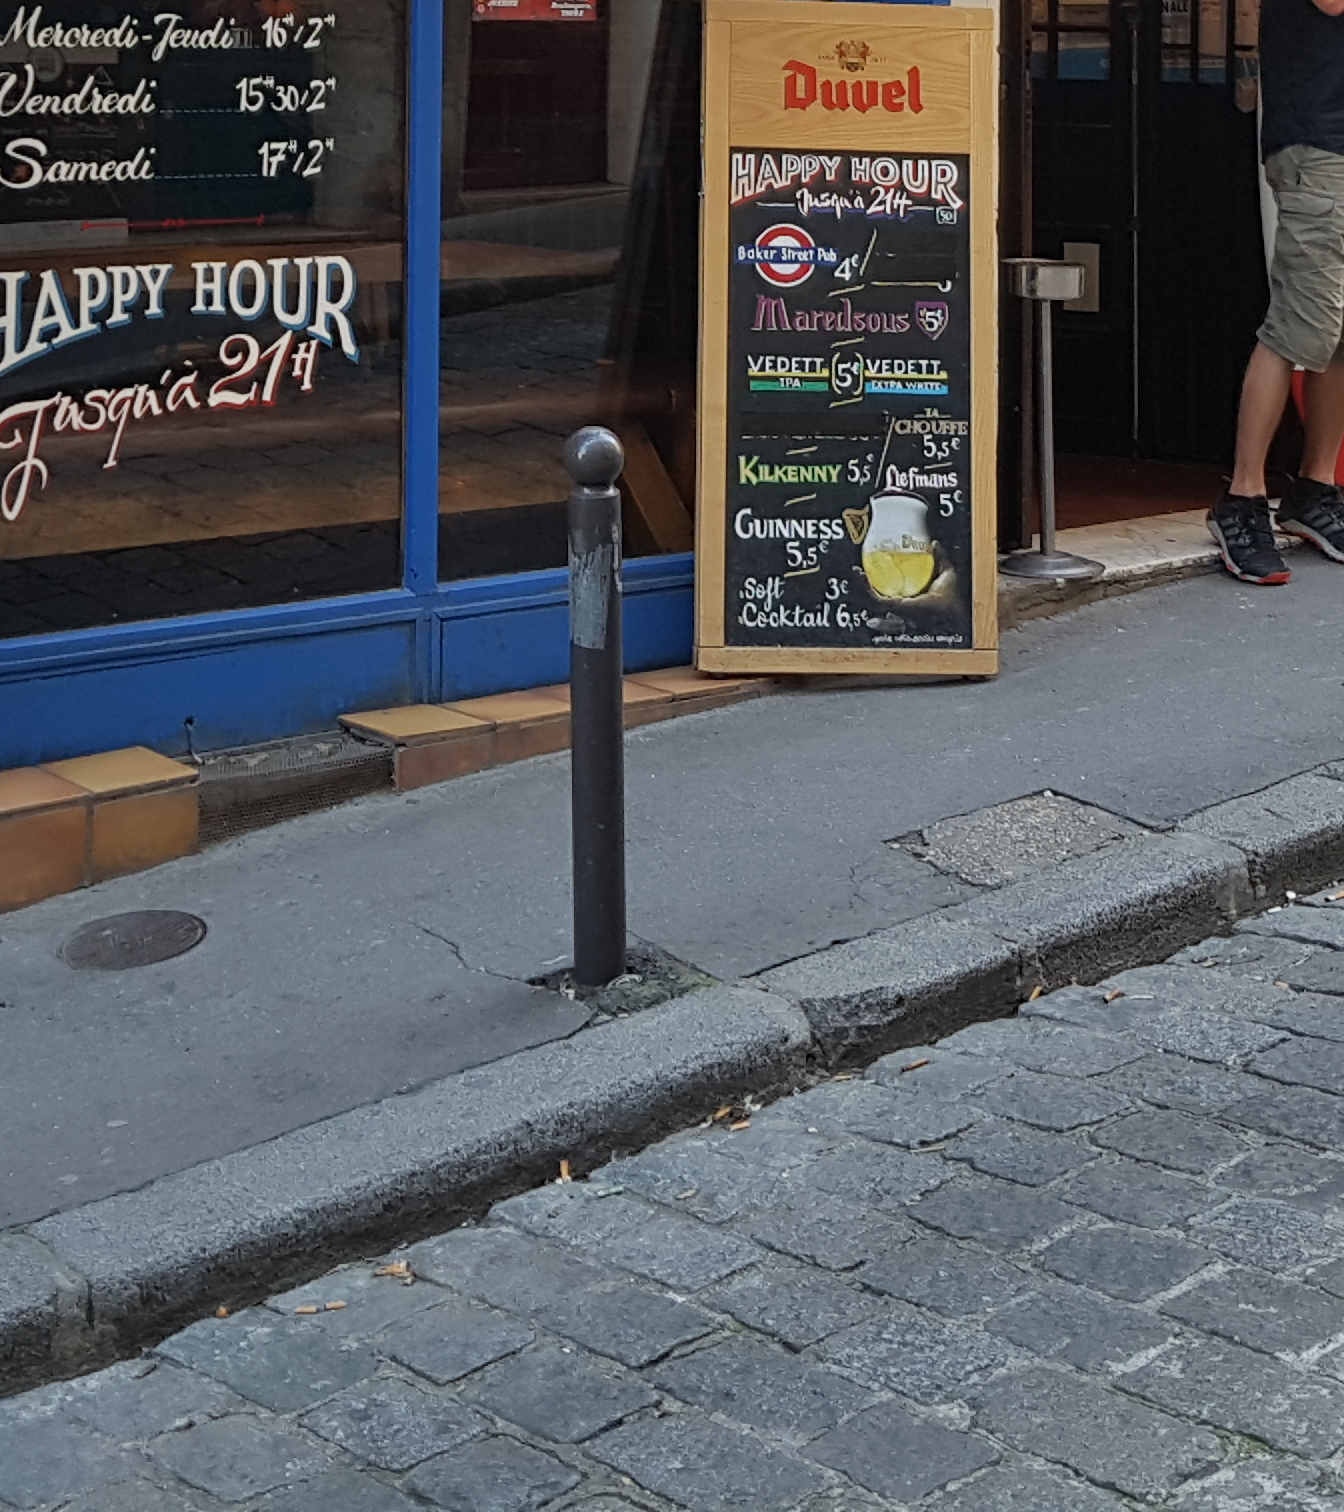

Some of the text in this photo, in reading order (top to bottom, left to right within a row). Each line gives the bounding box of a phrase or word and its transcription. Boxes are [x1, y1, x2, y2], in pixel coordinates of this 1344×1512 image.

[782, 59, 924, 114] Duvel
[730, 153, 964, 211] HAPPY HOUR
[737, 245, 837, 263] Baker Street Pub
[190, 255, 359, 363] HOUR
[750, 294, 910, 333] Maredsous
[207, 330, 319, 408] 21H
[748, 355, 825, 373] VEDETT
[866, 359, 942, 376] VEDETT
[779, 377, 801, 388] IPA
[871, 380, 903, 390] EXTRA
[894, 420, 969, 435] CHOUFFE
[738, 455, 843, 485] KILKENNY
[734, 508, 845, 539] GUINNESS
[743, 577, 784, 612] Soft
[741, 603, 830, 628] Cocktail
